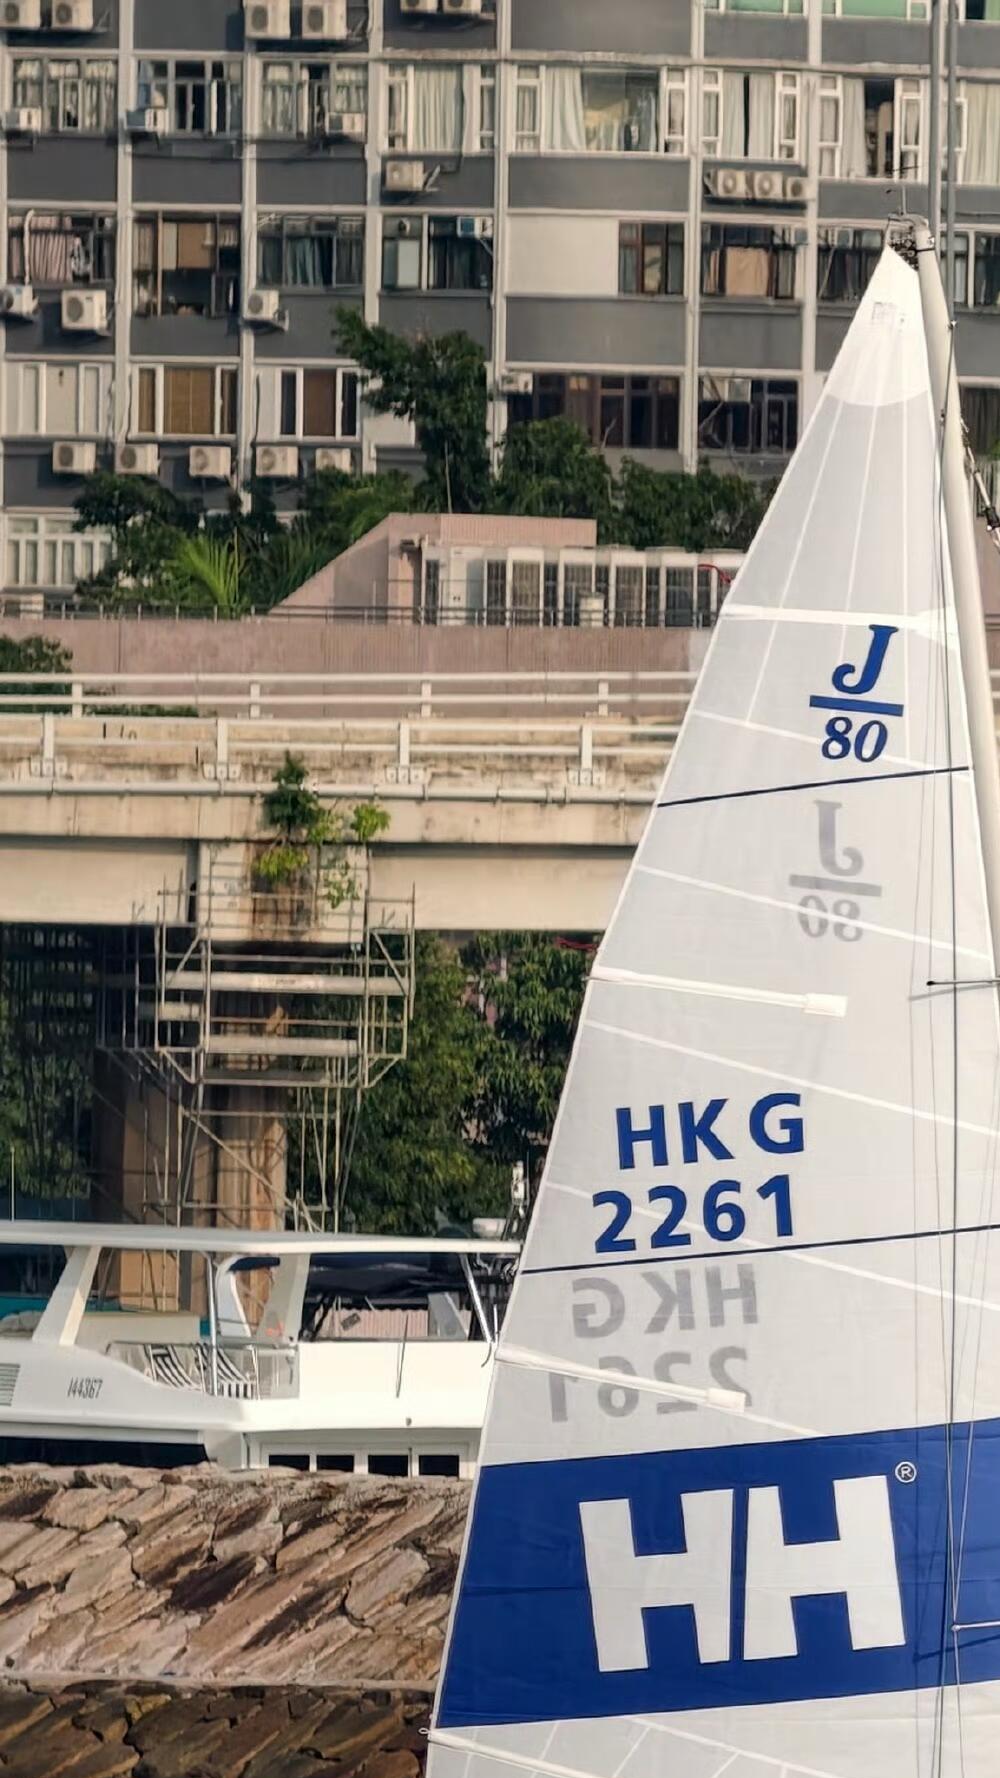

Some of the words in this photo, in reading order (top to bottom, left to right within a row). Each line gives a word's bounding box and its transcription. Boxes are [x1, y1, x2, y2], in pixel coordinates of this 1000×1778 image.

[832, 624, 899, 695] J
[821, 716, 889, 763] 80
[615, 1092, 805, 1169] HKG
[592, 1174, 795, 1253] 2261
[580, 1475, 906, 1672] HH
